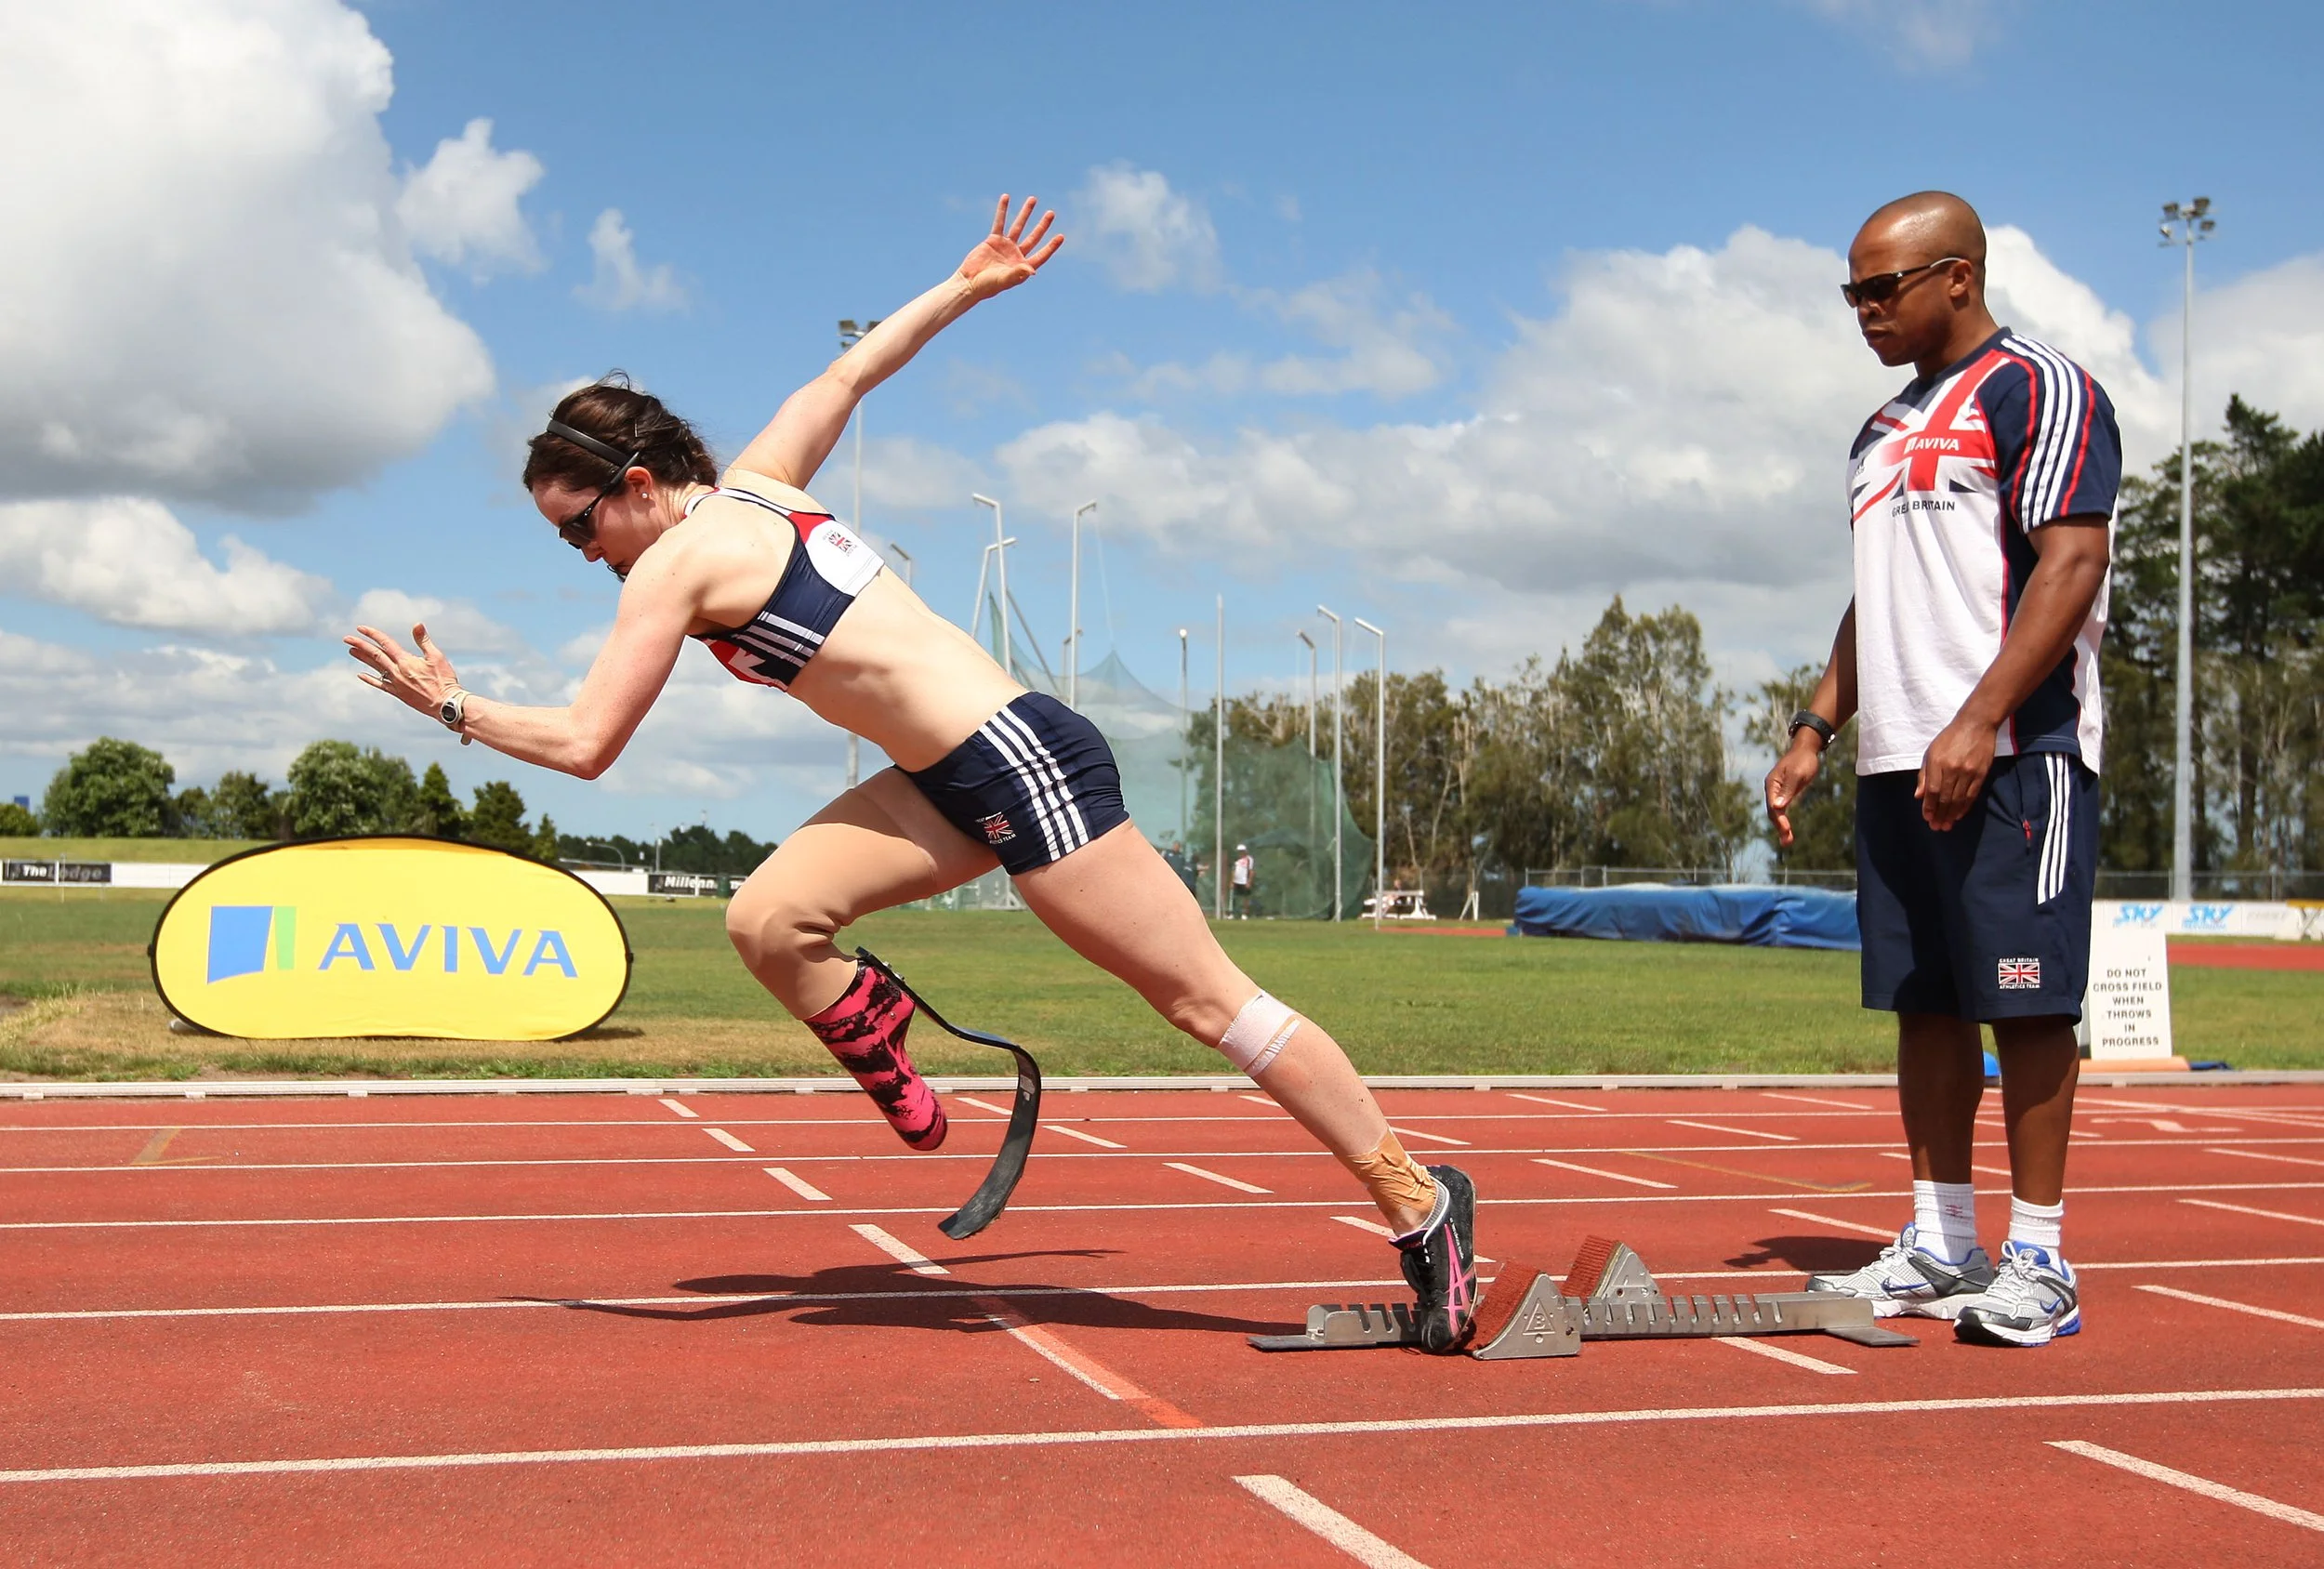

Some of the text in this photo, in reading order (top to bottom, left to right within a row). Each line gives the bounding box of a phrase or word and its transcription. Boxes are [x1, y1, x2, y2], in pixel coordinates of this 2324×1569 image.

[1915, 438, 1960, 451] AVIVA
[1912, 500, 1955, 510] BRITAIN
[317, 923, 578, 978] AVIVA
[2106, 969, 2146, 979] DO NOT
[2093, 982, 2162, 992] CROSS FIELD
[2112, 995, 2145, 1006] WHEN
[2106, 1009, 2152, 1020] THROWS
[2124, 1023, 2135, 1034] IN
[2102, 1037, 2159, 1048] PROGRESS
